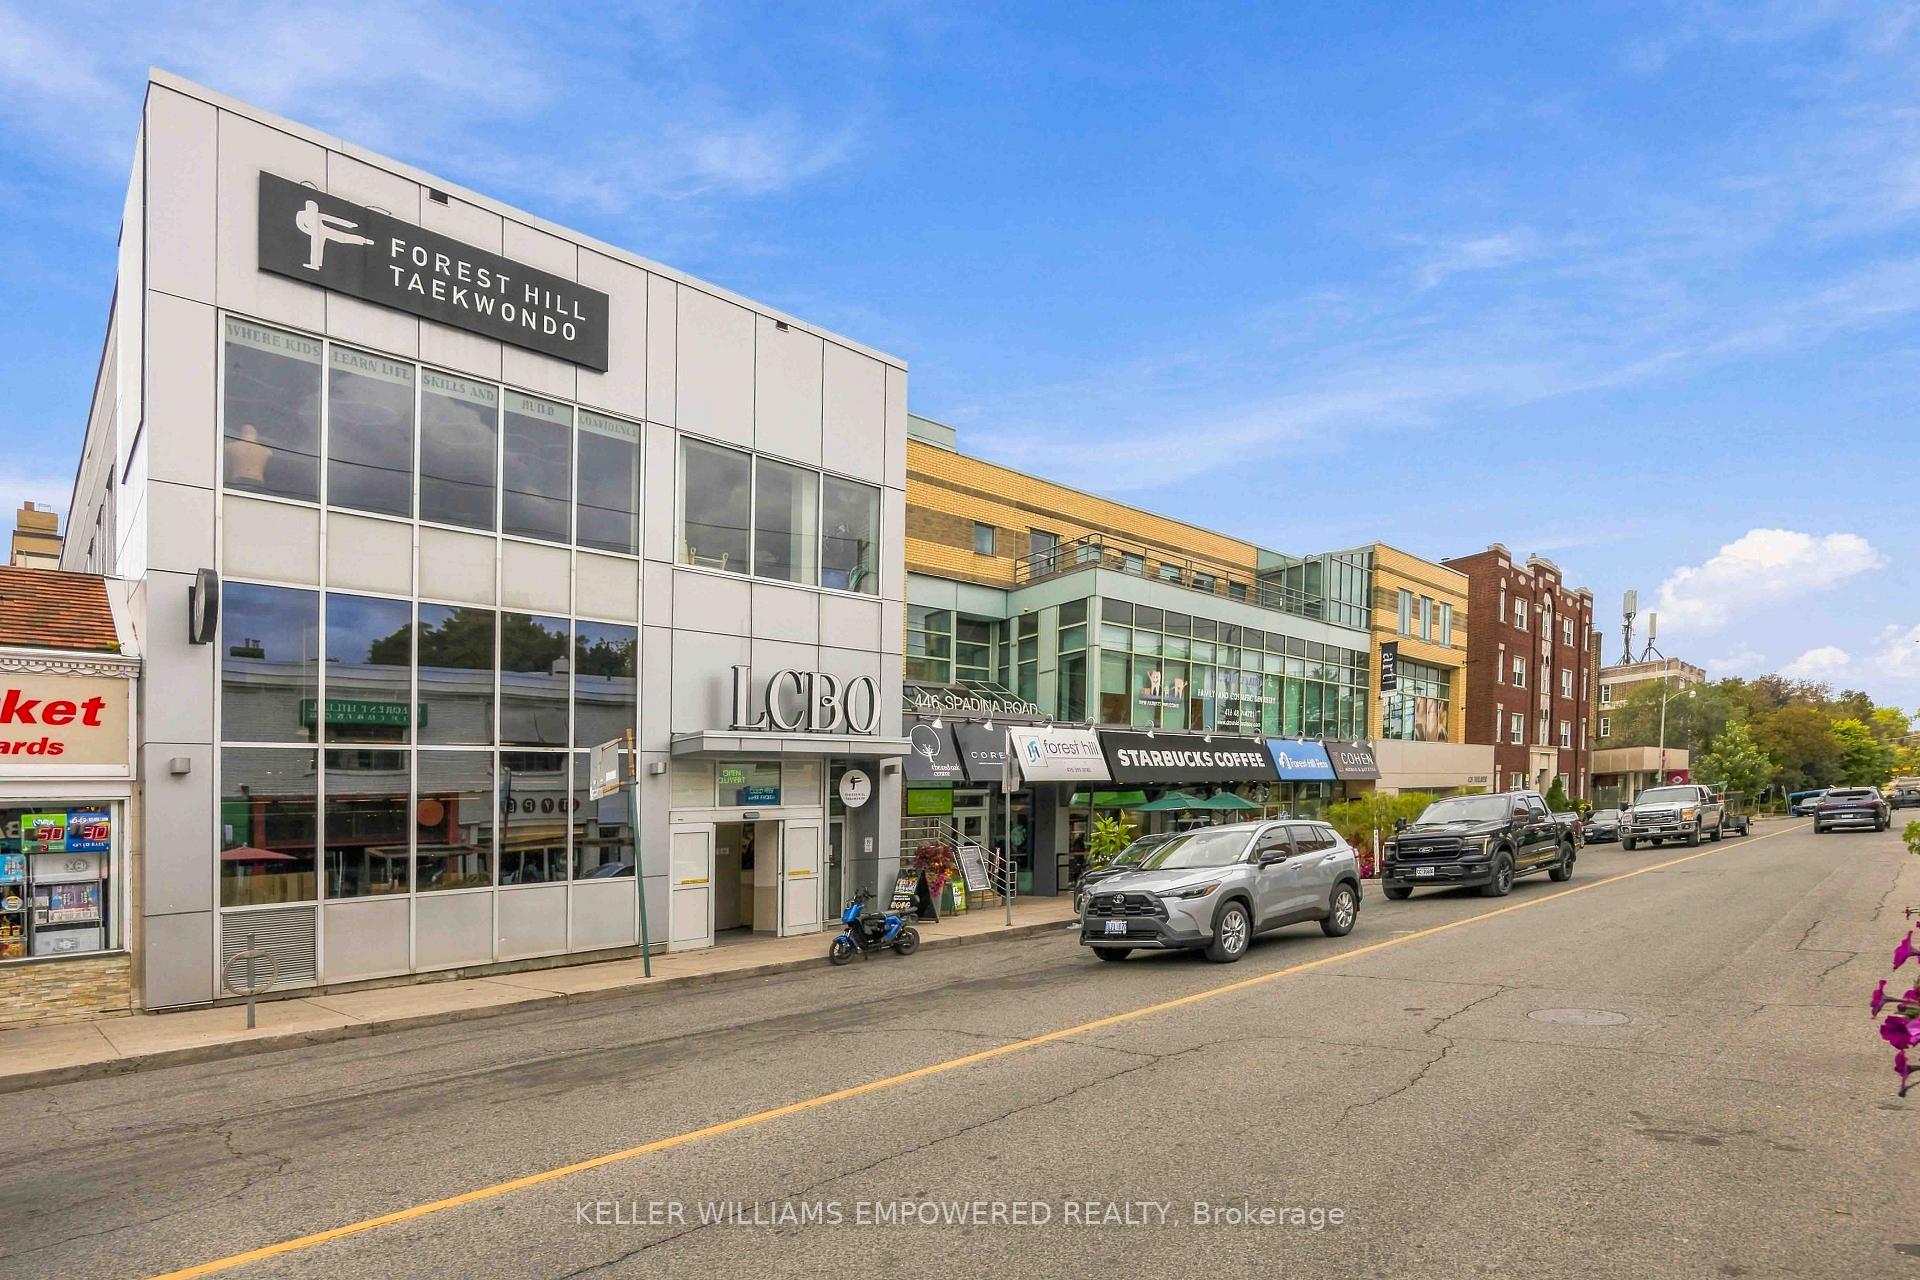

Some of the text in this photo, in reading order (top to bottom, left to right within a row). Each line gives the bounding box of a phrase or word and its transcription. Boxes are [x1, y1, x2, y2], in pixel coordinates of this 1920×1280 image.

[391, 238, 586, 321] FOREST HILL
[389, 264, 576, 341] TAEKWONDO
[228, 323, 281, 348] WHERE
[286, 338, 321, 357] KIDS
[334, 351, 378, 373] LEARN
[382, 363, 411, 381] LIFE
[423, 374, 466, 394] SKILLS
[470, 387, 494, 401] AND
[730, 665, 882, 733] LCBO
[914, 694, 1038, 715] 446 SPADINA ROAD
[1044, 739, 1099, 755] forest hill
[1117, 749, 1266, 767] STARBUCKS COFFEE
[1340, 752, 1375, 765] COHEN
[722, 769, 742, 777] OPEN
